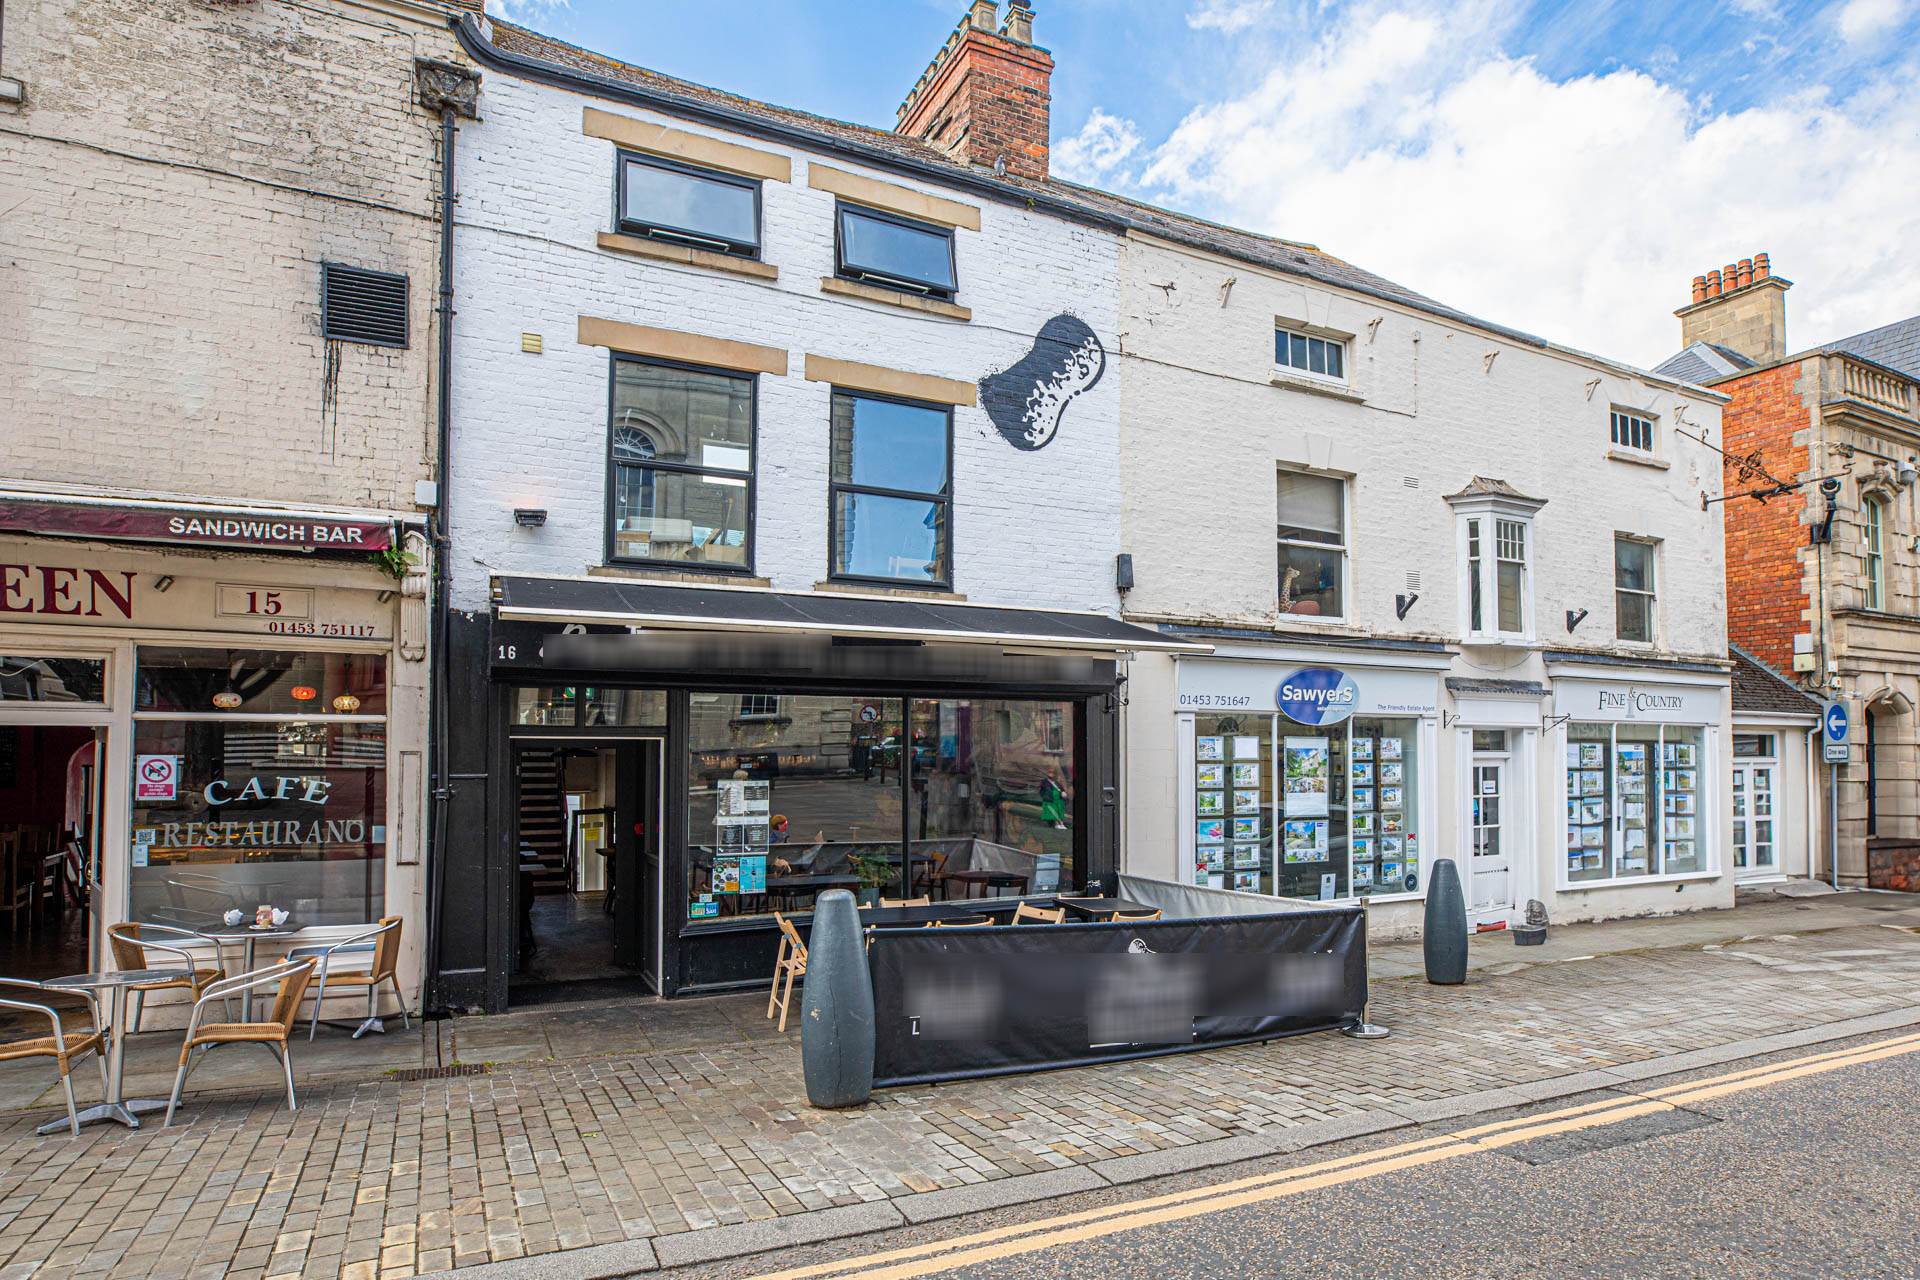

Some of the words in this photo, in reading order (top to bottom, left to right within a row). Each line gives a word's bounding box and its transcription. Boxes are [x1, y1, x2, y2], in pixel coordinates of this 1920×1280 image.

[168, 517, 305, 541] SANDWICH
[312, 525, 364, 543] BAR
[0, 564, 138, 619] EEN
[246, 591, 282, 615] 15
[268, 621, 316, 634] 01453
[320, 623, 376, 637] 751117
[498, 645, 517, 660] 16
[1180, 694, 1212, 706] 01453
[1214, 695, 1251, 707] 751647
[1598, 691, 1626, 710] FINE
[1628, 686, 1637, 699] &
[1636, 693, 1684, 712] COUNTRY
[203, 776, 333, 806] CAFE
